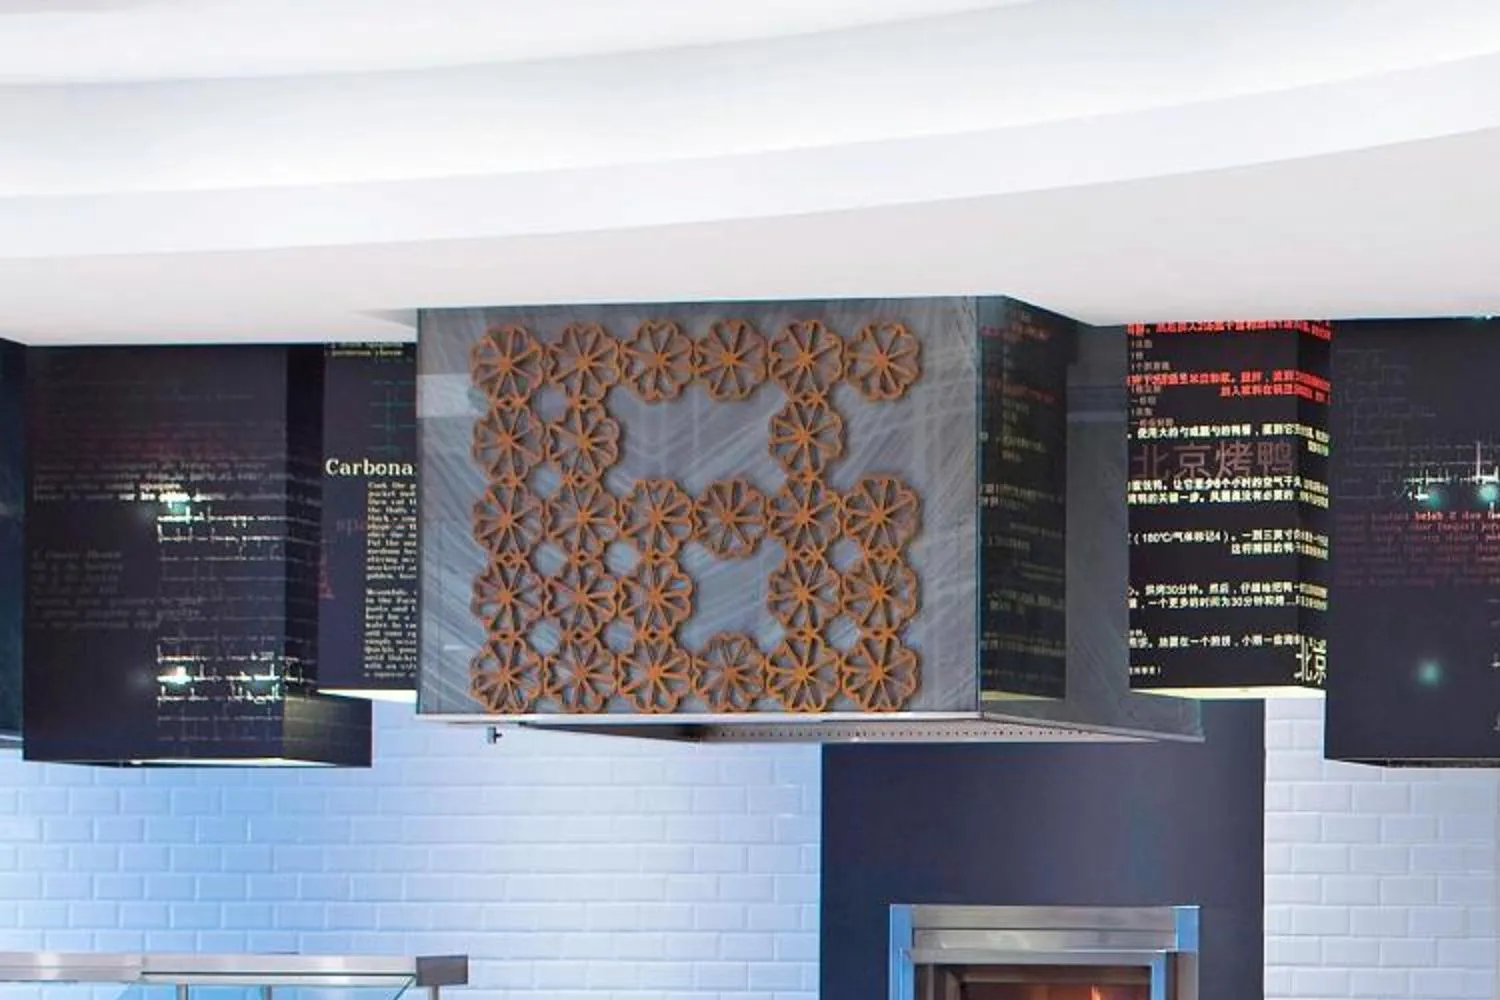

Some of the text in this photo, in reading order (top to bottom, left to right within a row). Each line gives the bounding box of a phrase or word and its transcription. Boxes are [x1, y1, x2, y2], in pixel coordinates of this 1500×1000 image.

[325, 458, 417, 476] Carbona
[1132, 440, 1294, 479] 北京烤鸭
